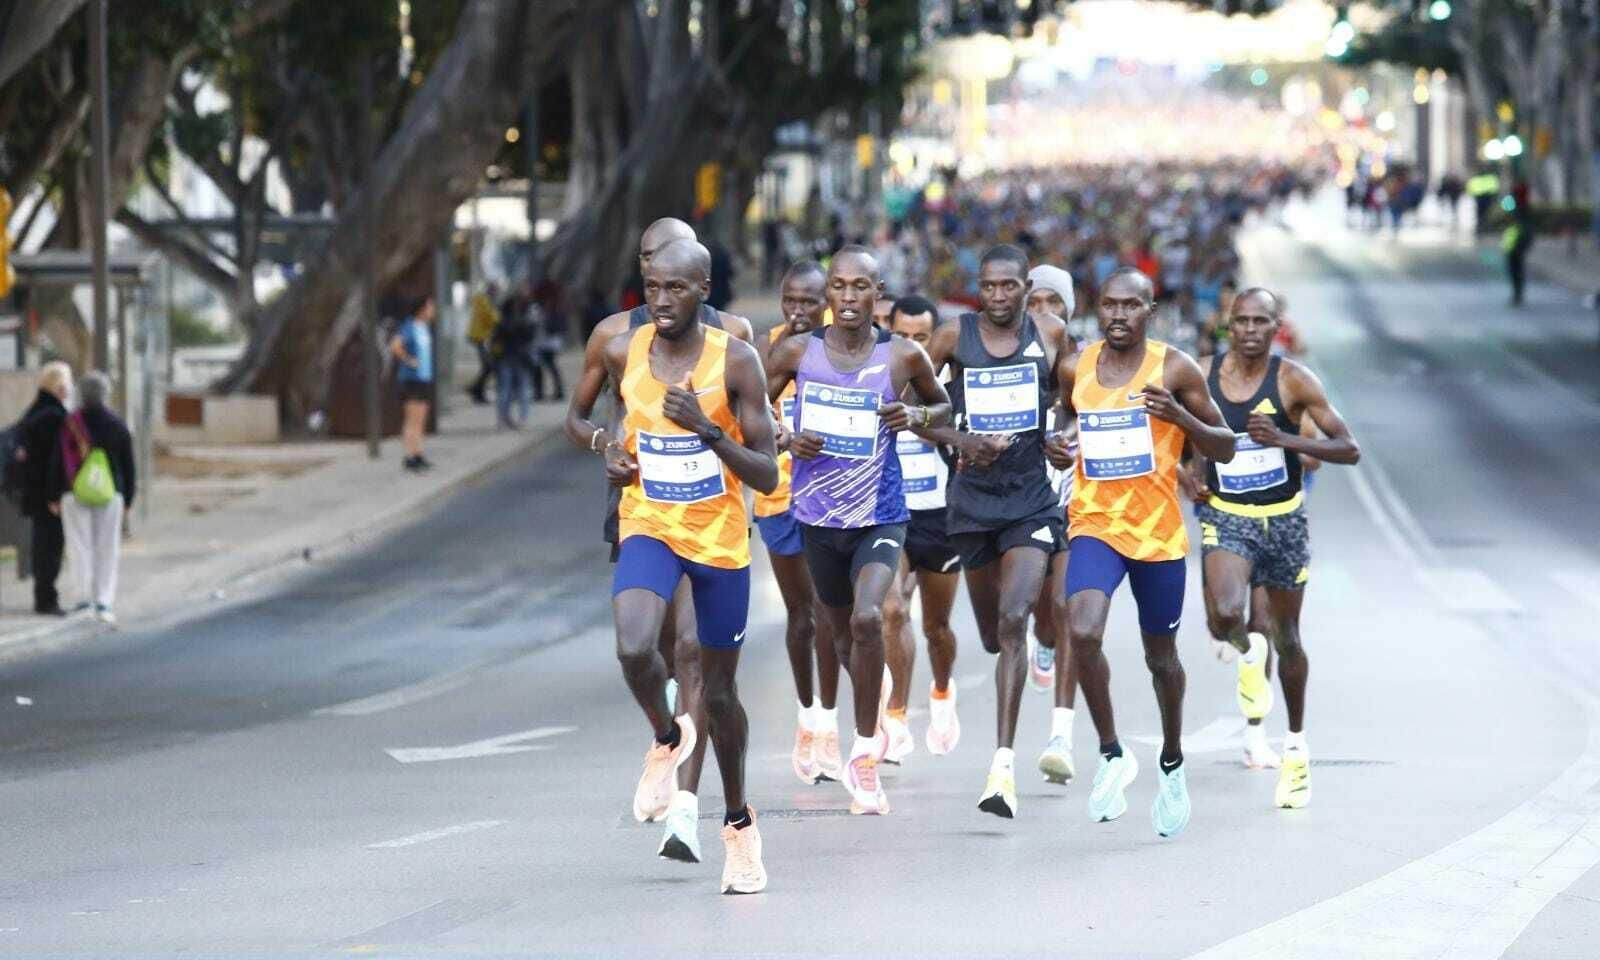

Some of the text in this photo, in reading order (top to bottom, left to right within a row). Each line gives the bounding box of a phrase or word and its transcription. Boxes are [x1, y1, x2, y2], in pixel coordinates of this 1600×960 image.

[832, 392, 865, 404] ZURICH
[665, 439, 702, 449] ZURICH
[683, 460, 699, 471] 13
